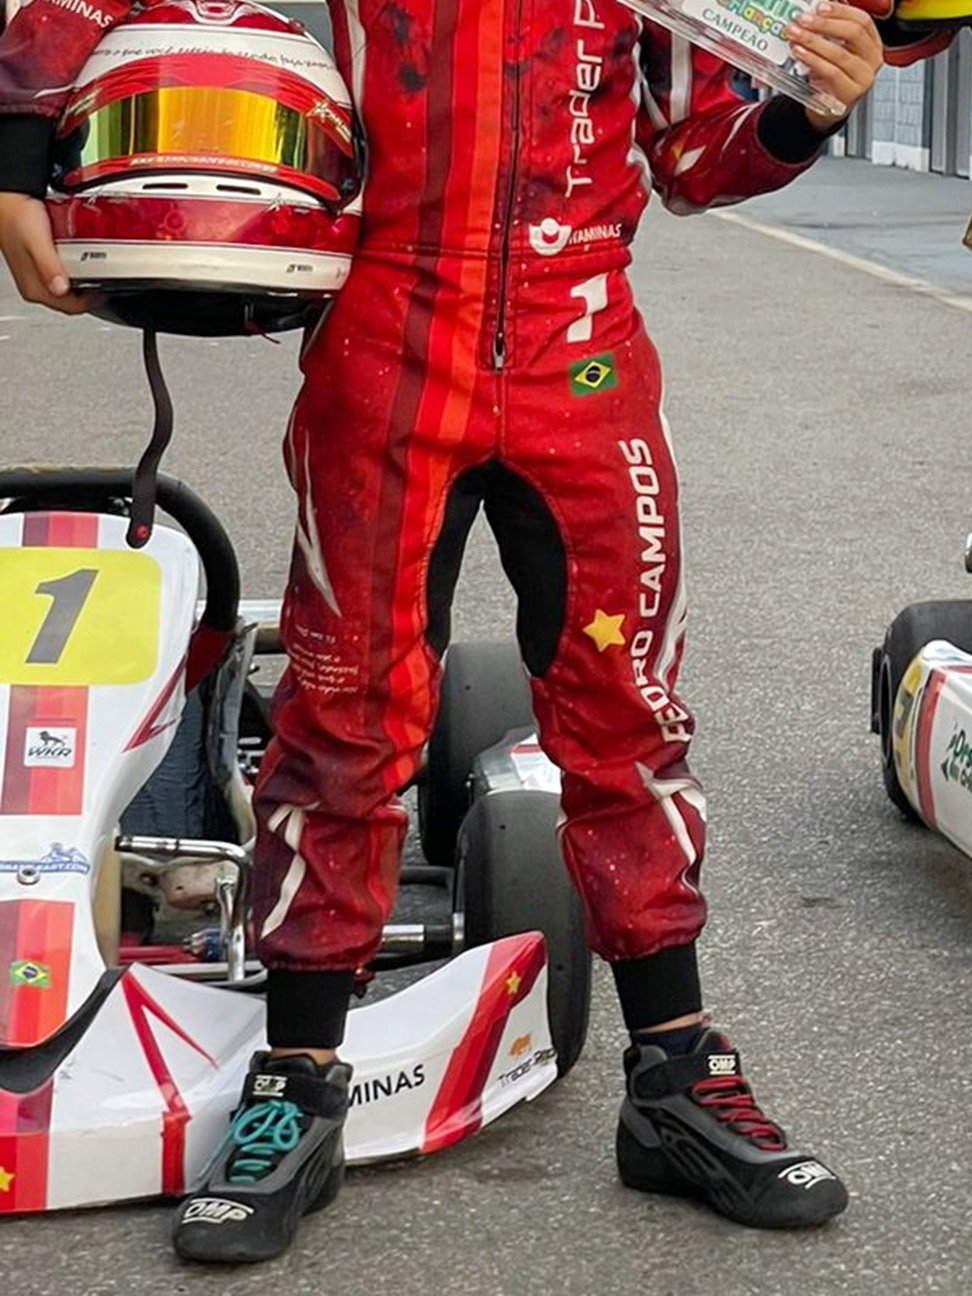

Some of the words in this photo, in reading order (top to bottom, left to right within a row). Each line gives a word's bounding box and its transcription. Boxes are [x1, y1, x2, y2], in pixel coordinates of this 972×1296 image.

[565, 39, 602, 198] Trader
[619, 438, 667, 618] CAMPOS
[25, 568, 99, 664] 1
[349, 1064, 425, 1107] MINAS
[183, 1200, 250, 1222] OMP
